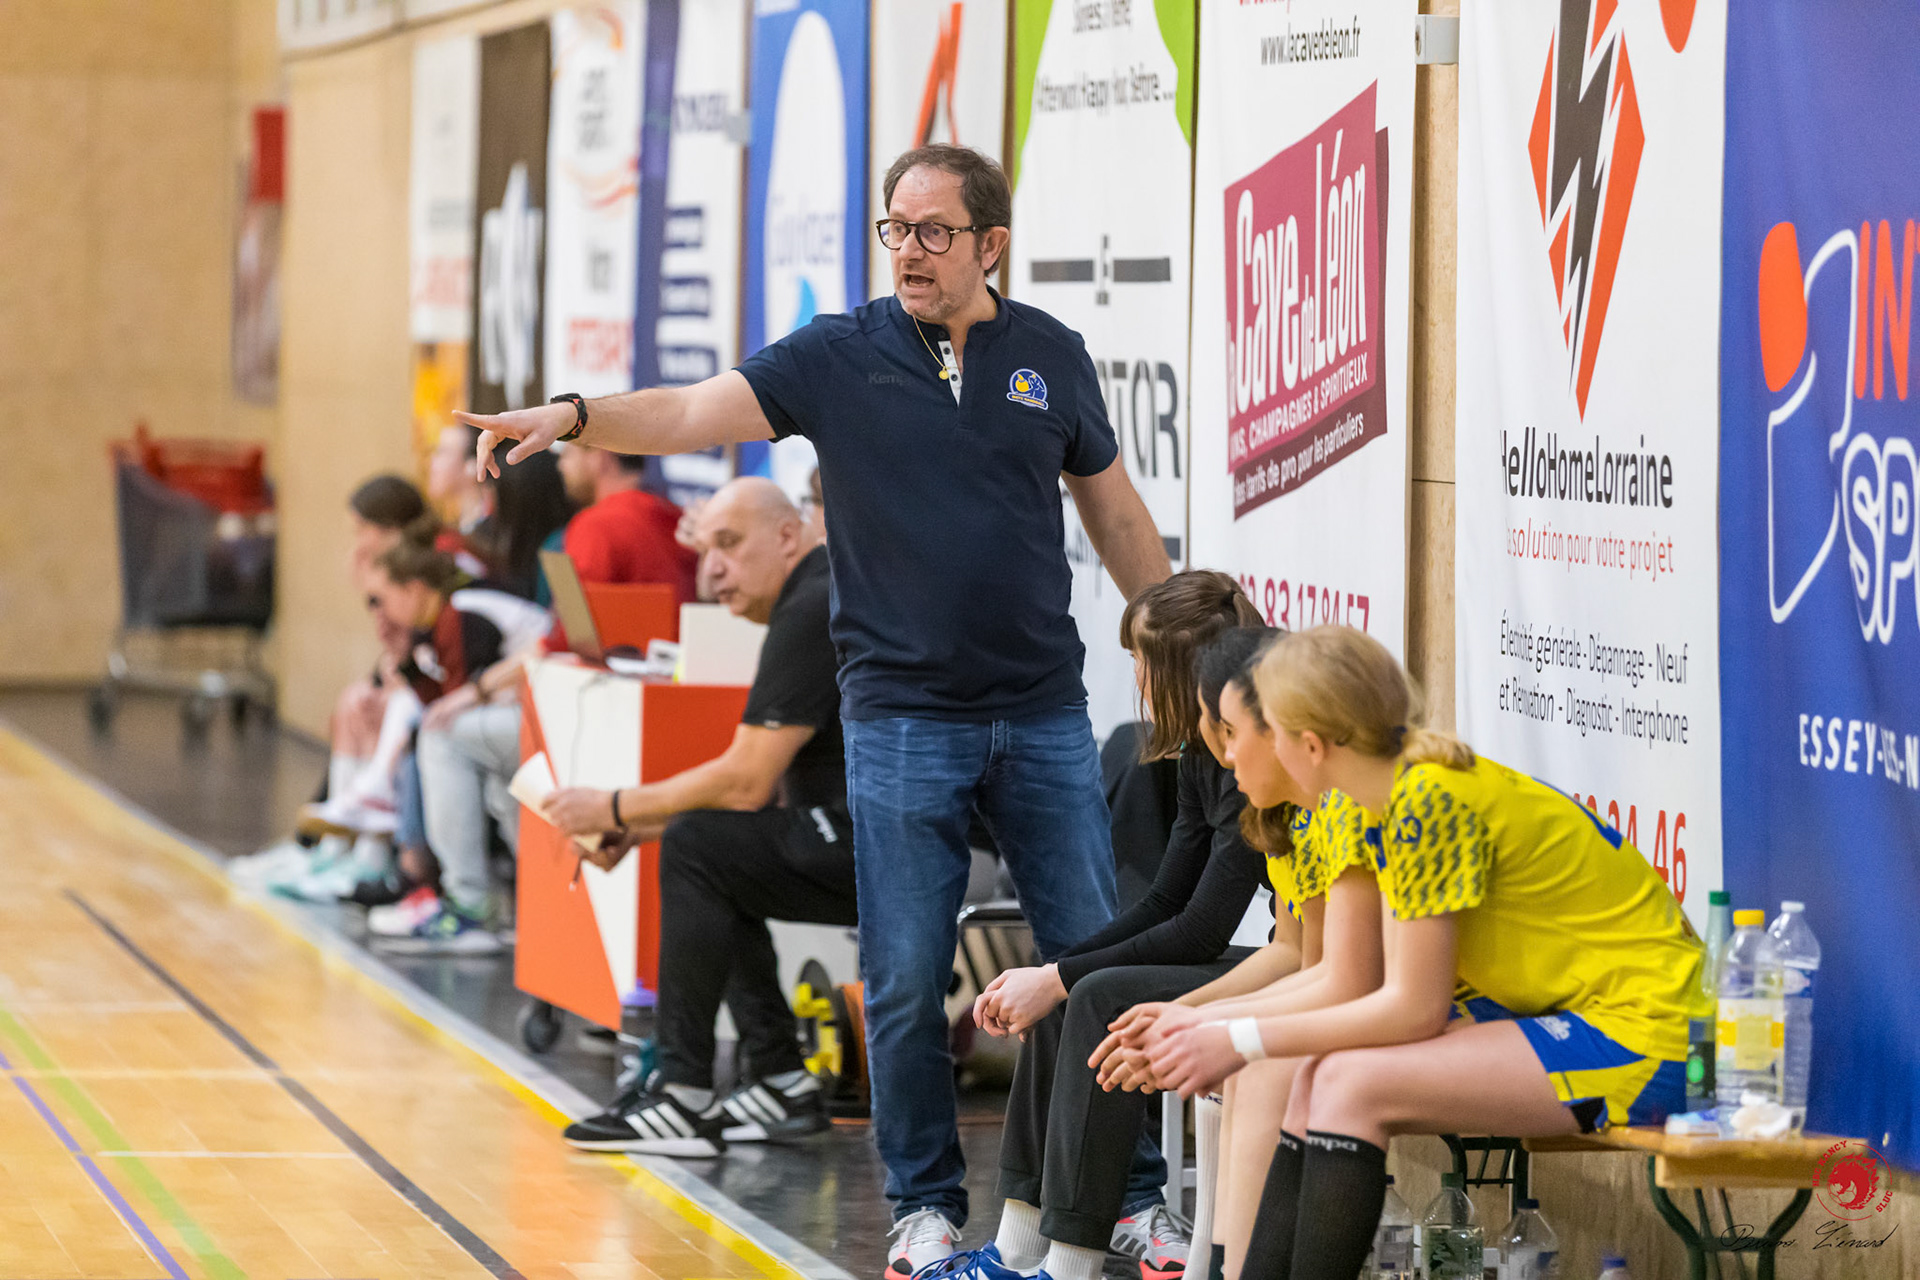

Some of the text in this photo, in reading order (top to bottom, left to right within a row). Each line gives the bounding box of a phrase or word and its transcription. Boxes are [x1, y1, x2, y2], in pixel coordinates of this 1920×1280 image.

[1260, 15, 1361, 66] www.lacavedeleon.fr
[1237, 189, 1299, 414] Cave
[1300, 274, 1315, 382] de
[1315, 128, 1367, 373] Léon
[1854, 219, 1920, 401] IN
[1248, 391, 1313, 450] CHAMPAGNES
[1320, 352, 1368, 410] SPIRITUEUX
[1266, 459, 1280, 489] de
[1280, 455, 1297, 490] pro
[1297, 444, 1313, 481] pour
[1313, 434, 1324, 465] les
[1323, 412, 1364, 465] particuliers
[1512, 517, 1564, 561] solution
[1566, 533, 1593, 573] pour
[1595, 531, 1626, 569] votre
[1629, 530, 1674, 582] projet
[1842, 432, 1920, 645] SP
[1535, 624, 1581, 673] générale
[1589, 632, 1645, 688] Dépannage
[1656, 643, 1689, 684] Neuf
[1500, 677, 1510, 711] et
[1512, 675, 1555, 722] Réation
[1566, 687, 1613, 737] Diagnostic
[1622, 697, 1689, 750] Interphone
[1653, 810, 1687, 906] 46
